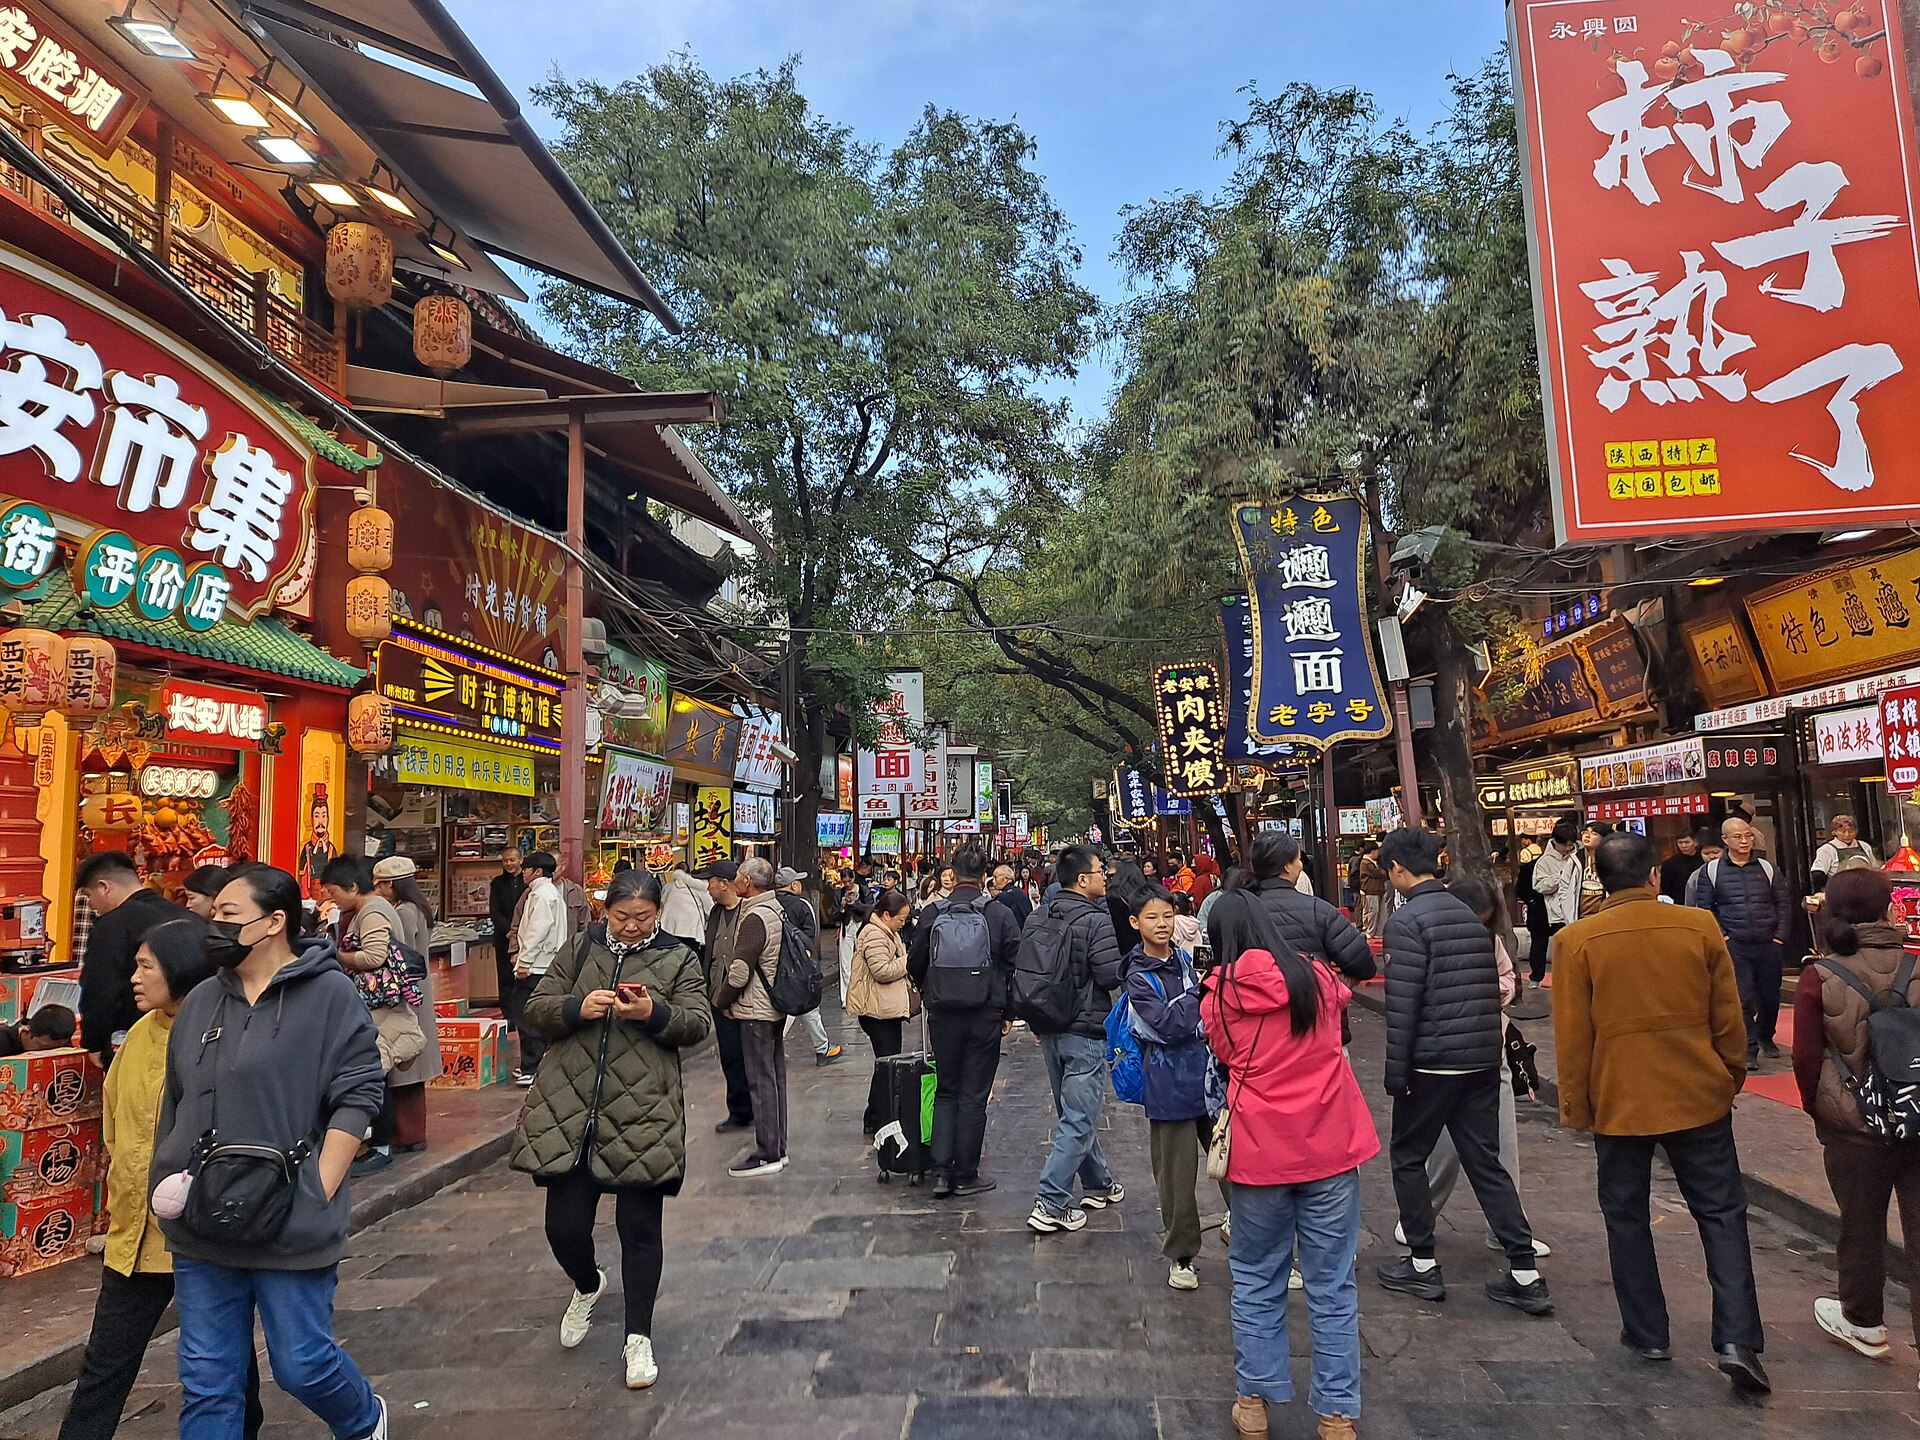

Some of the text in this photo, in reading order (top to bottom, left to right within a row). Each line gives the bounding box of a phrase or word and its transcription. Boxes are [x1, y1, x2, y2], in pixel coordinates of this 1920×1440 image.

[1608, 441, 1718, 466] 陕西特产
[1610, 470, 1721, 497] 全国包邮
[1269, 506, 1341, 534] 特色
[464, 573, 548, 638] 时光杂货铺
[1161, 675, 1211, 694] 老安家
[460, 673, 550, 729] 时光博物馆
[1268, 698, 1374, 727] 老字号
[168, 692, 264, 740] 长安八绝
[1176, 694, 1216, 789] 肉夹馍
[471, 758, 531, 787] 快乐是必需品
[871, 782, 914, 793] 牛肉面
